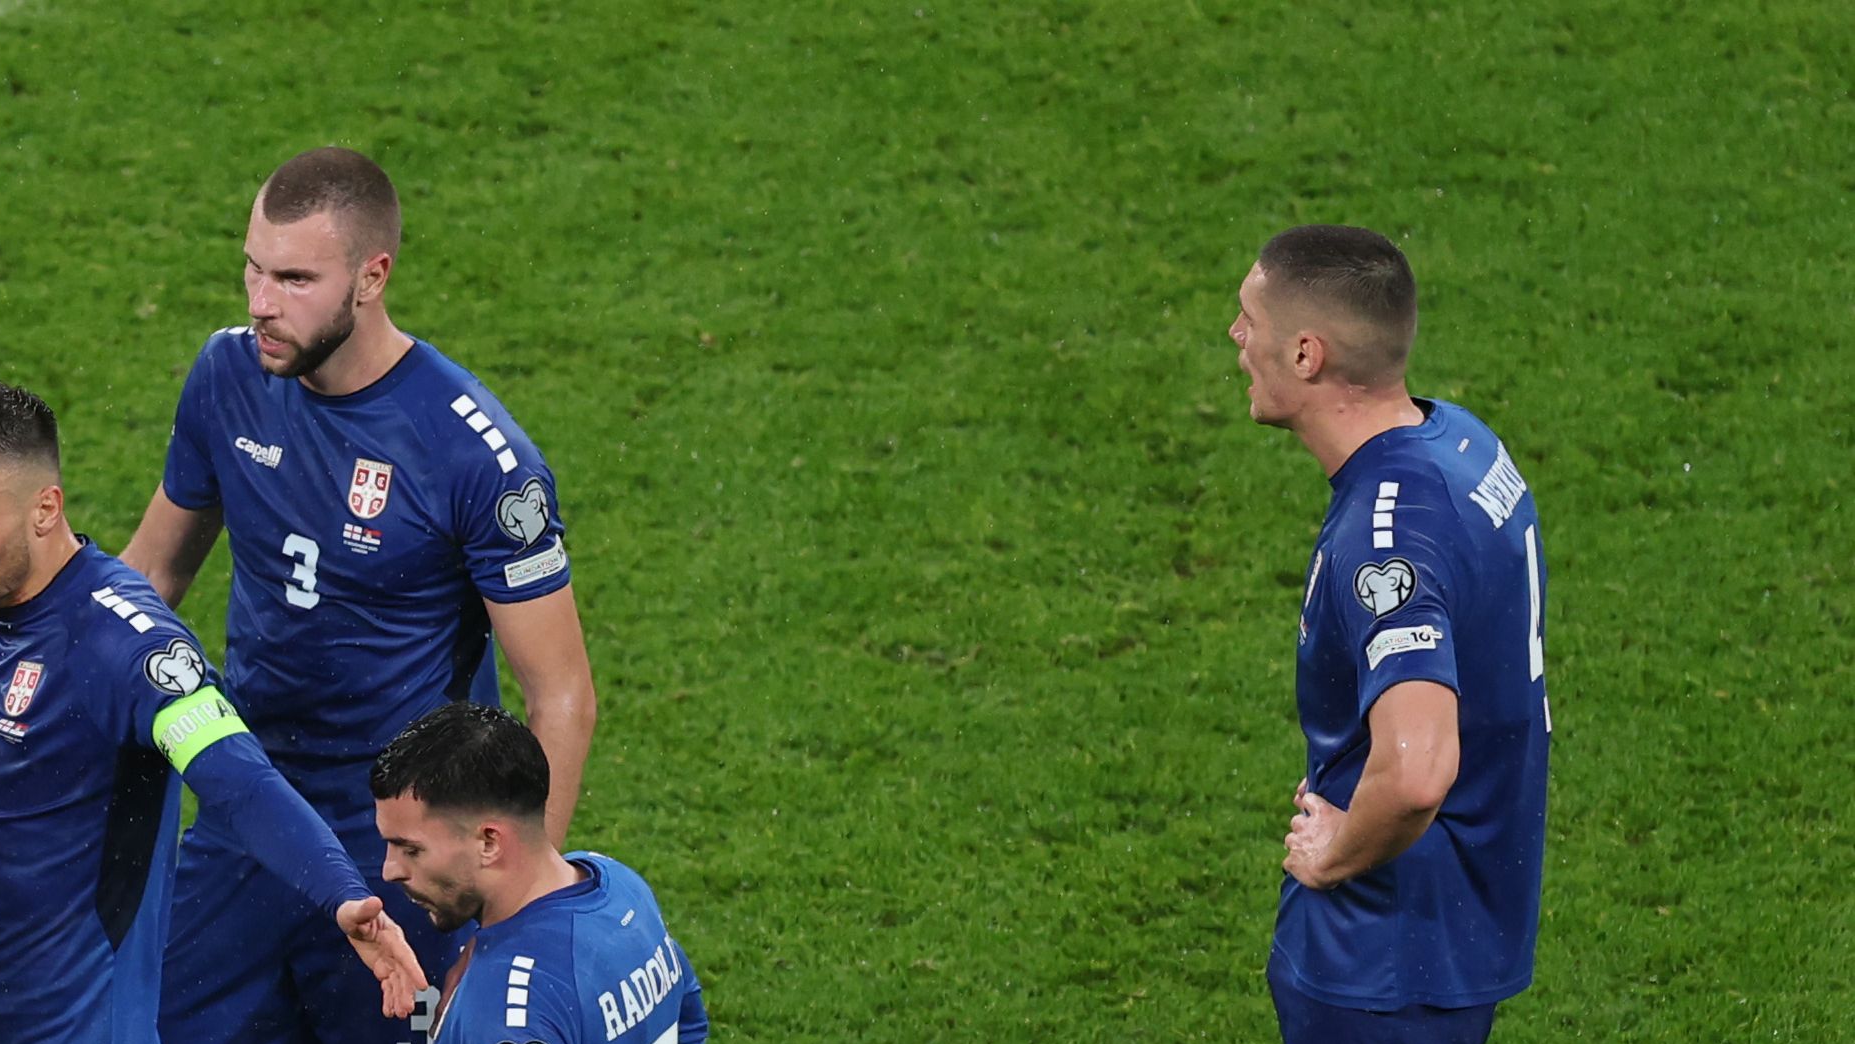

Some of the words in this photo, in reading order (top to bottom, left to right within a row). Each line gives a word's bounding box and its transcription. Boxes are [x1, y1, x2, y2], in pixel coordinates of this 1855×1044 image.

[235, 436, 283, 464] capelli
[281, 532, 321, 610] 3
[598, 930, 683, 1041] RADONJ
